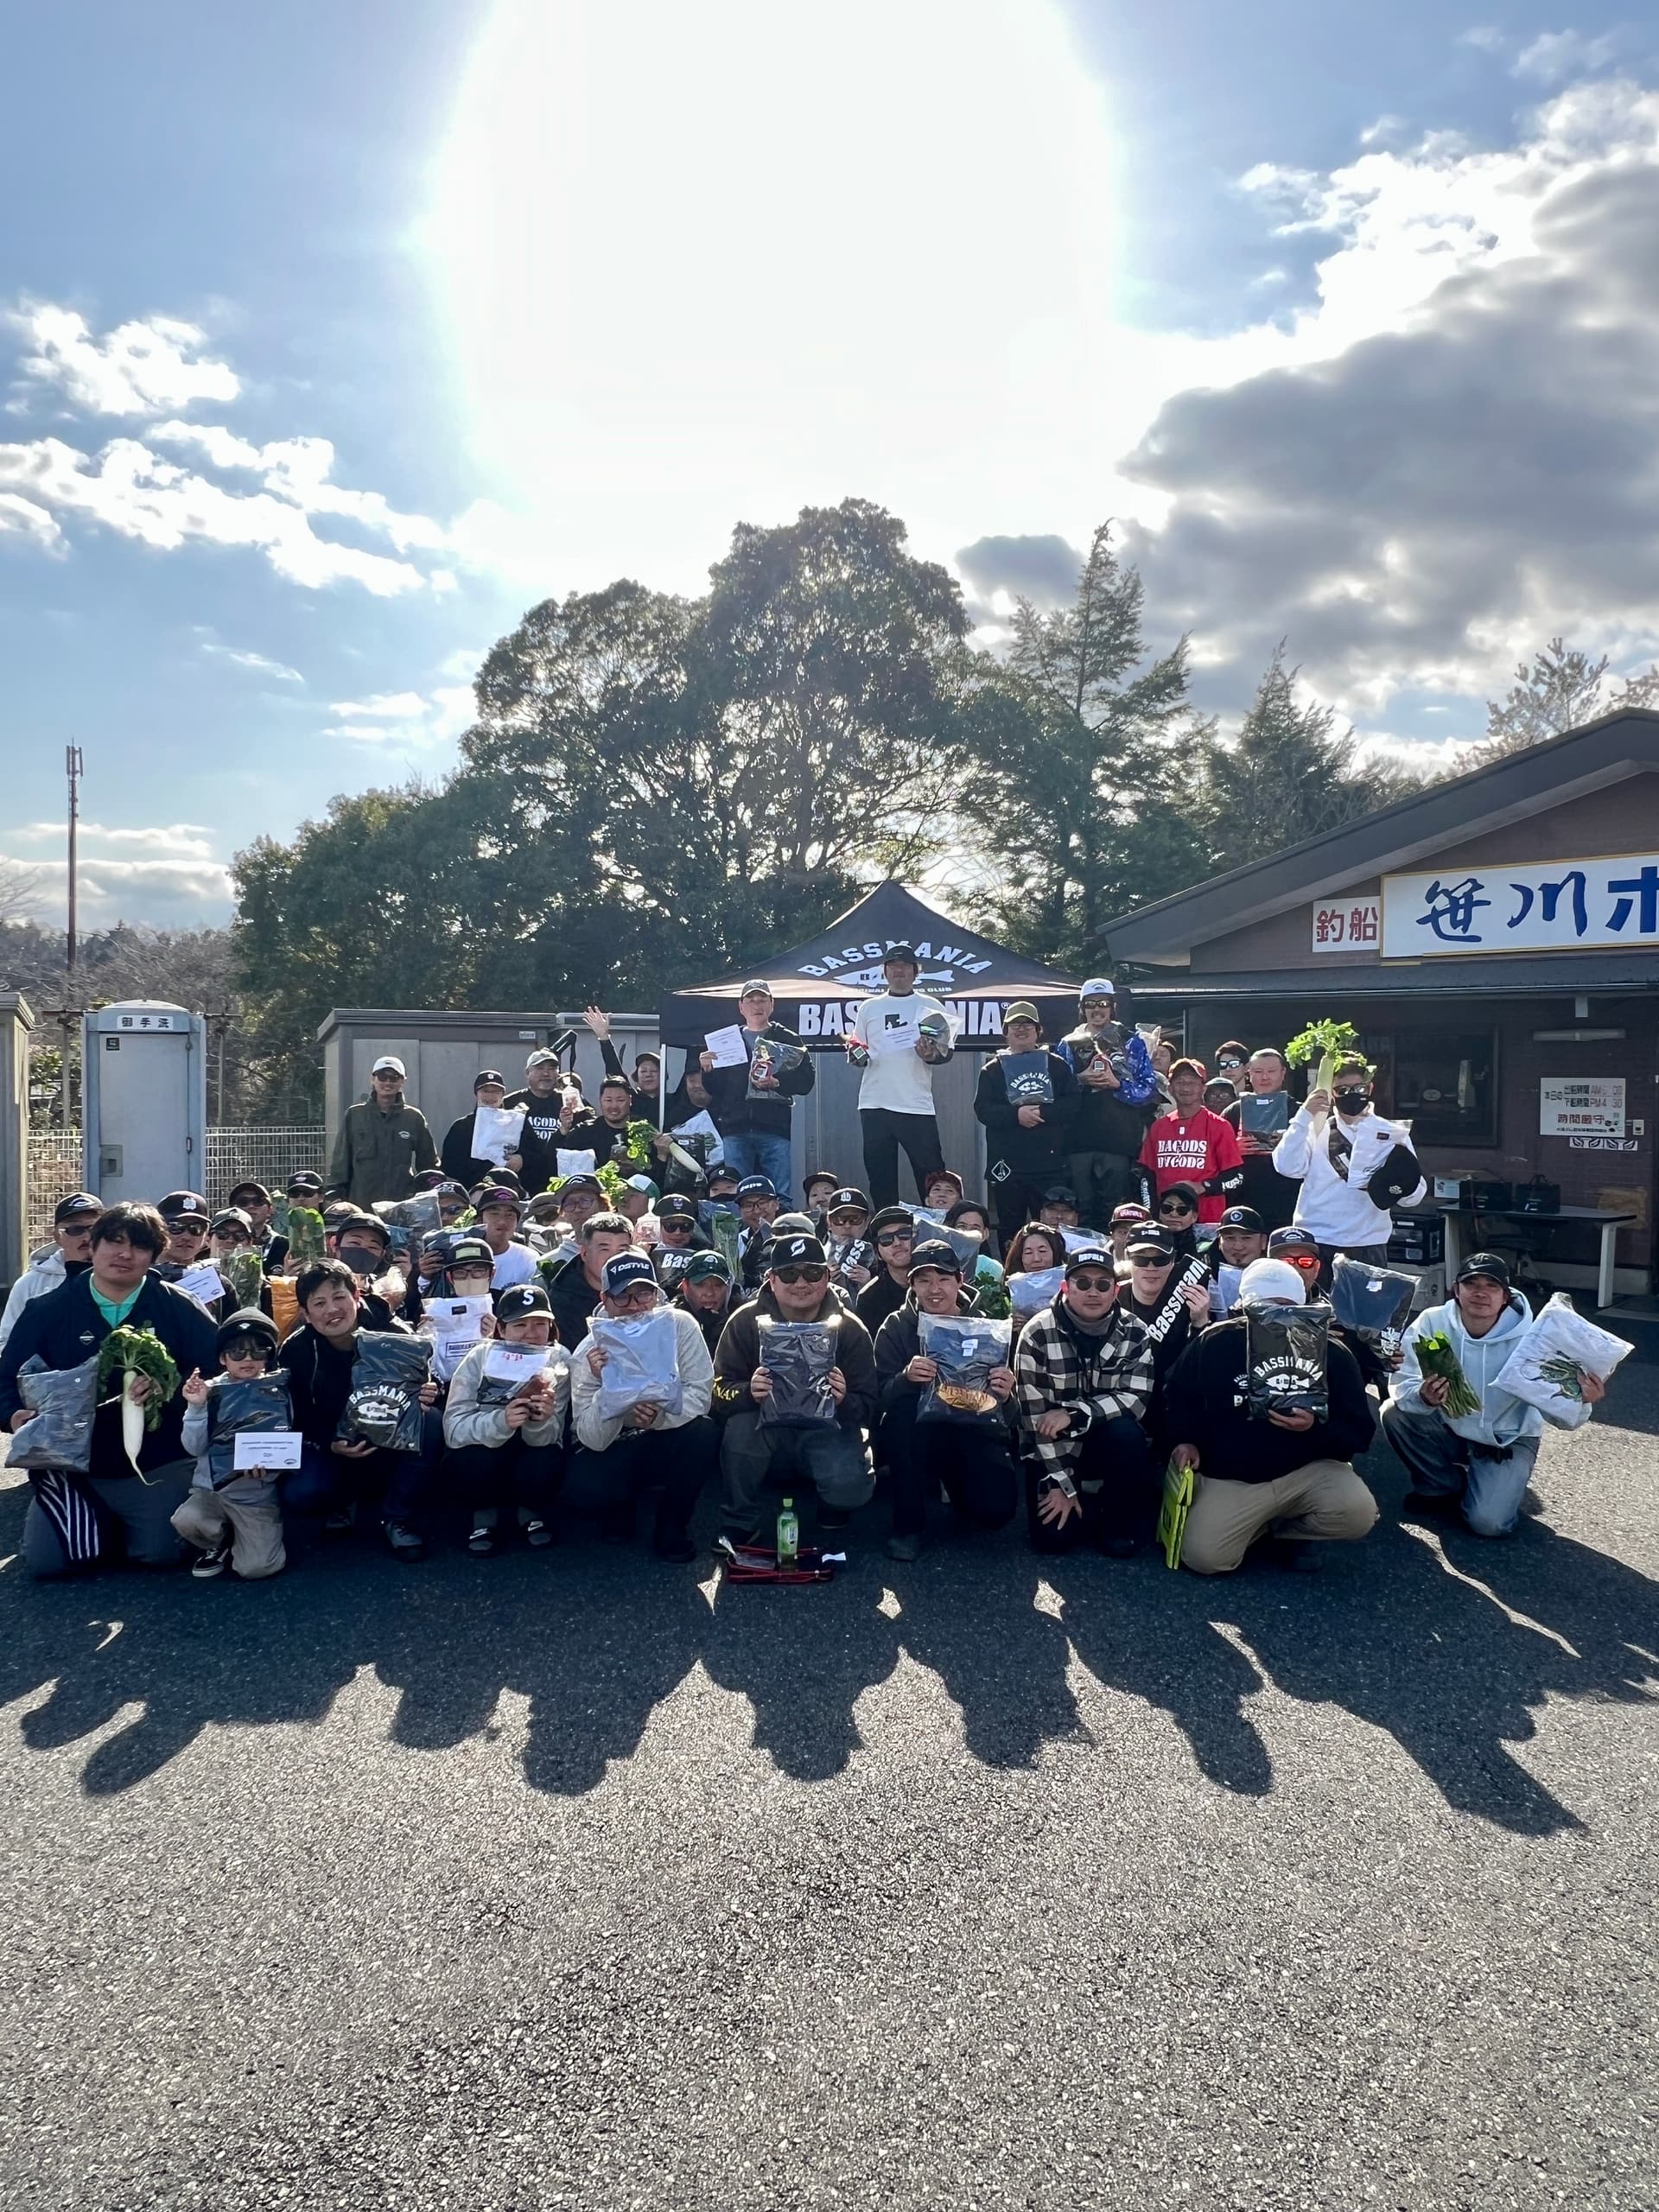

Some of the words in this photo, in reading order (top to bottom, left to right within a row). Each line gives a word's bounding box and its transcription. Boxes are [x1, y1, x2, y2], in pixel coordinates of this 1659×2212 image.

[1317, 907, 1378, 943] 釣船
[798, 1000, 1003, 1036] BASNIA
[522, 1289, 534, 1306] S
